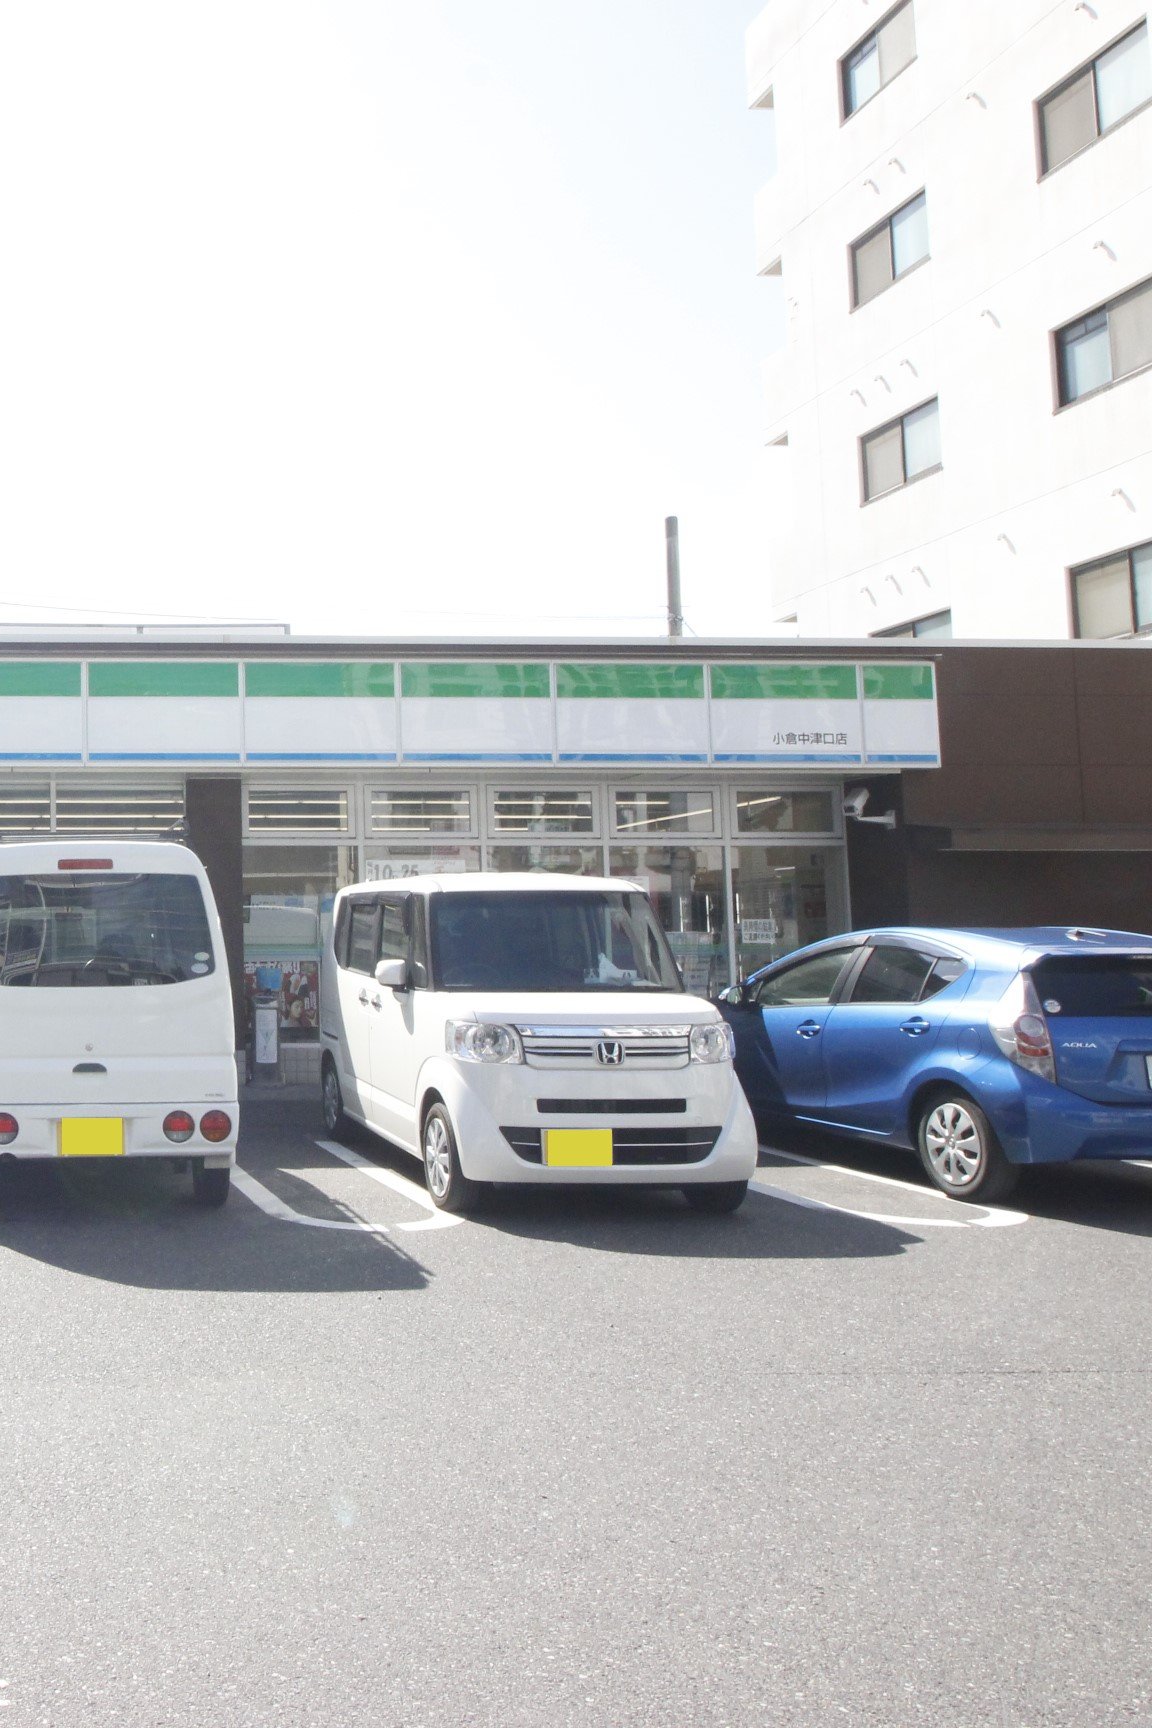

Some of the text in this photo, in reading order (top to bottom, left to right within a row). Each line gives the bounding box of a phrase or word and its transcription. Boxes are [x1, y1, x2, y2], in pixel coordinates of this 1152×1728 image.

[772, 732, 848, 746] 小倉中津口店
